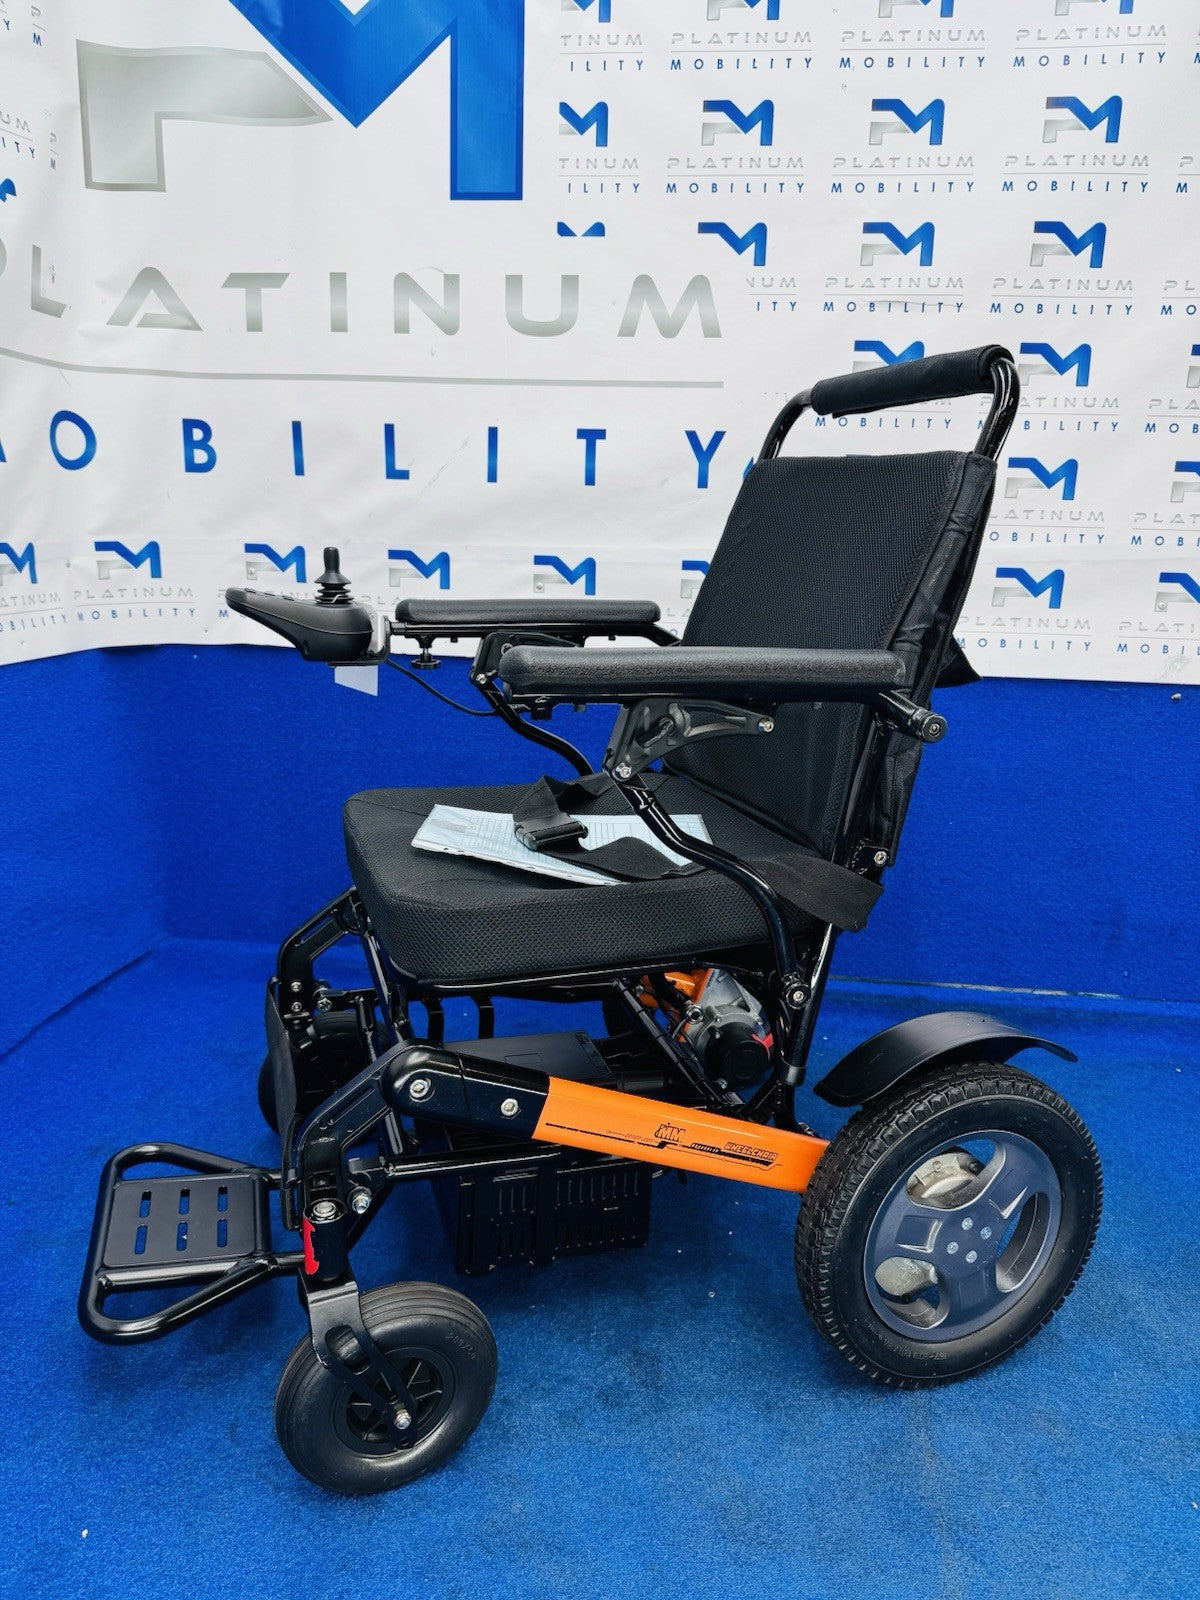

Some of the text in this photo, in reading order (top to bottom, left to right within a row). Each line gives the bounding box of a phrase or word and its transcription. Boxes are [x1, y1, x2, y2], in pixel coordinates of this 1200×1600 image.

[670, 32, 811, 44] PLATINUM
[841, 29, 985, 42] PLATINUM
[1015, 25, 1166, 40] PLATINUM
[670, 58, 811, 70] MOBILITY
[839, 57, 985, 68] MOBILITY
[1013, 53, 1166, 67] MOBILITY
[667, 157, 803, 168] PLATINUM
[832, 156, 974, 168] PLATINUM
[1004, 155, 1149, 167] PLATINUM
[666, 182, 804, 193] MOBILITY
[831, 182, 974, 193] MOBILITY
[1002, 180, 1148, 192] MOBILITY
[0, 238, 722, 338] LATINUM
[825, 277, 963, 288] PLATINUM
[993, 277, 1133, 291] PLATINUM
[823, 302, 963, 312] MOBILITY
[990, 303, 1133, 315] MOBILITY
[981, 395, 1119, 408] PATINUM
[815, 417, 951, 429] MOBILITY
[978, 418, 1119, 431] BILITY
[0, 410, 726, 488] OBILITY
[74, 587, 194, 600] PLATINUM
[78, 608, 196, 621] MOBILITY
[958, 616, 1091, 629] PLATINUM
